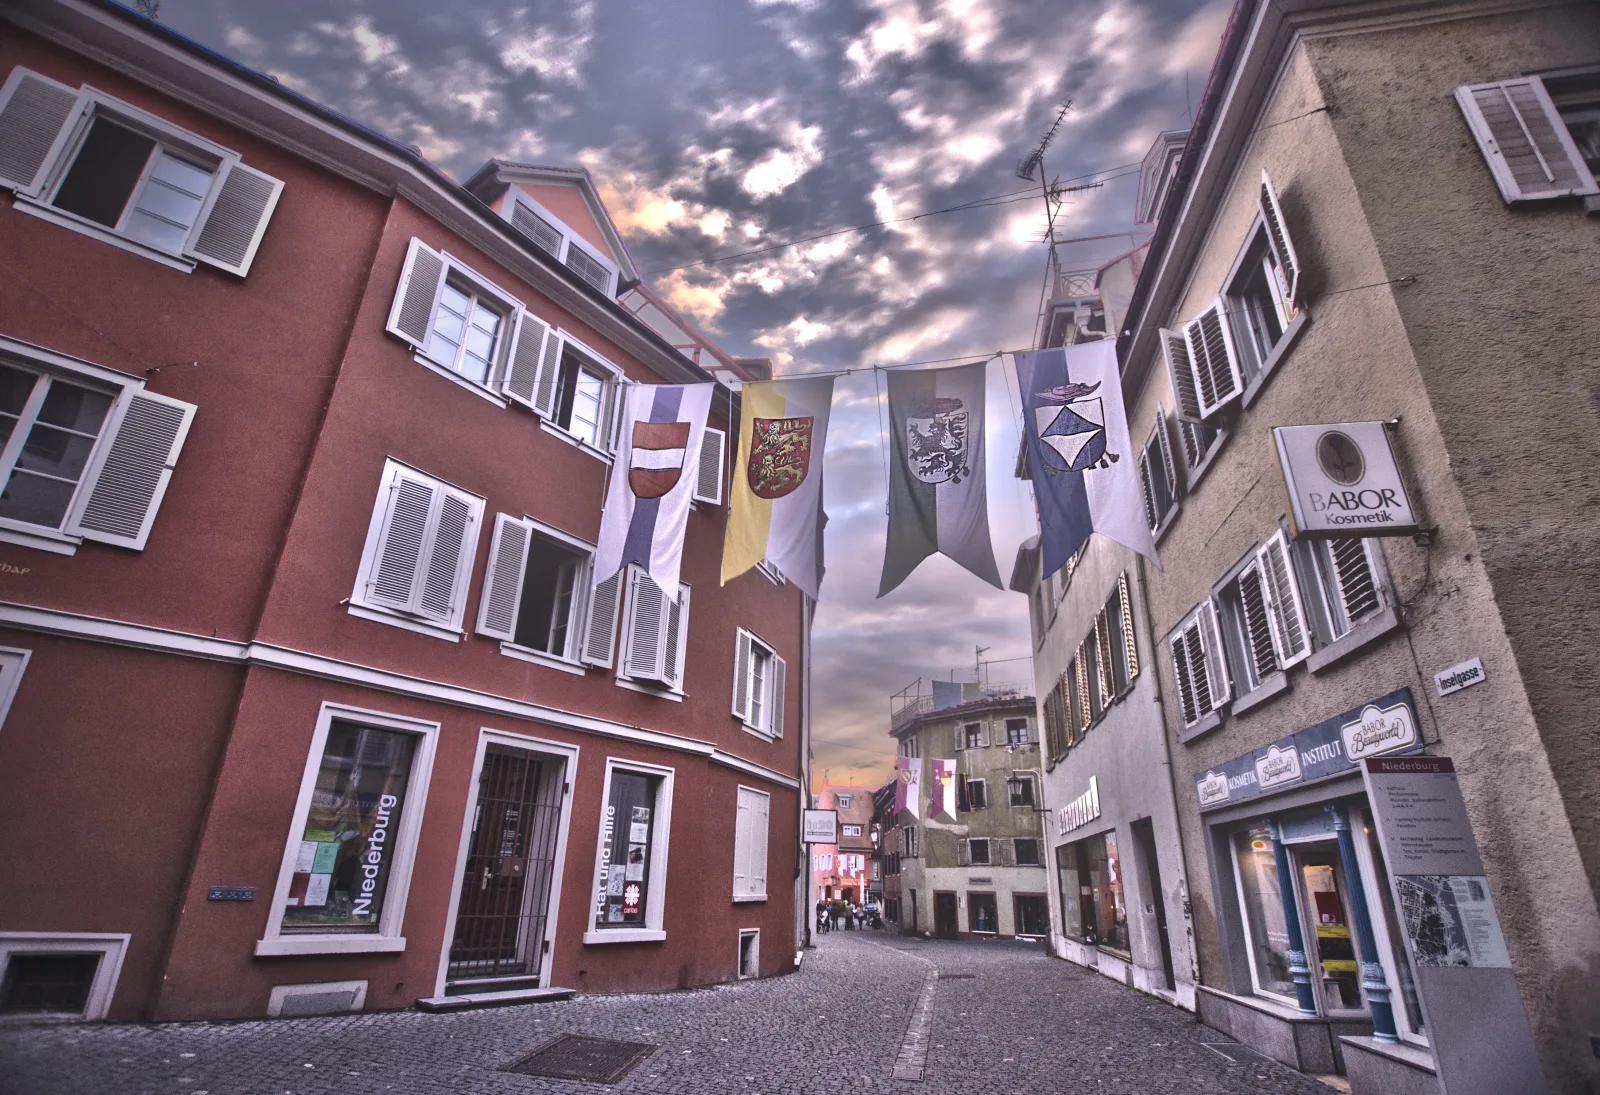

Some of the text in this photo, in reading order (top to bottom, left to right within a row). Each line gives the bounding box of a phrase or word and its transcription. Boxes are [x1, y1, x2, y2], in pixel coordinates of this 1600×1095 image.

[1309, 489, 1402, 512] BABOR
[1325, 510, 1394, 525] Kosmetik
[1438, 667, 1480, 690] Inselgasse
[1351, 718, 1405, 753] Beautyworld
[1361, 718, 1386, 735] BABOR
[1301, 740, 1341, 767] INSTITUT
[1382, 762, 1440, 771] Niederburg
[1229, 770, 1257, 790] KOSMETIK
[352, 794, 397, 915] Niederburg
